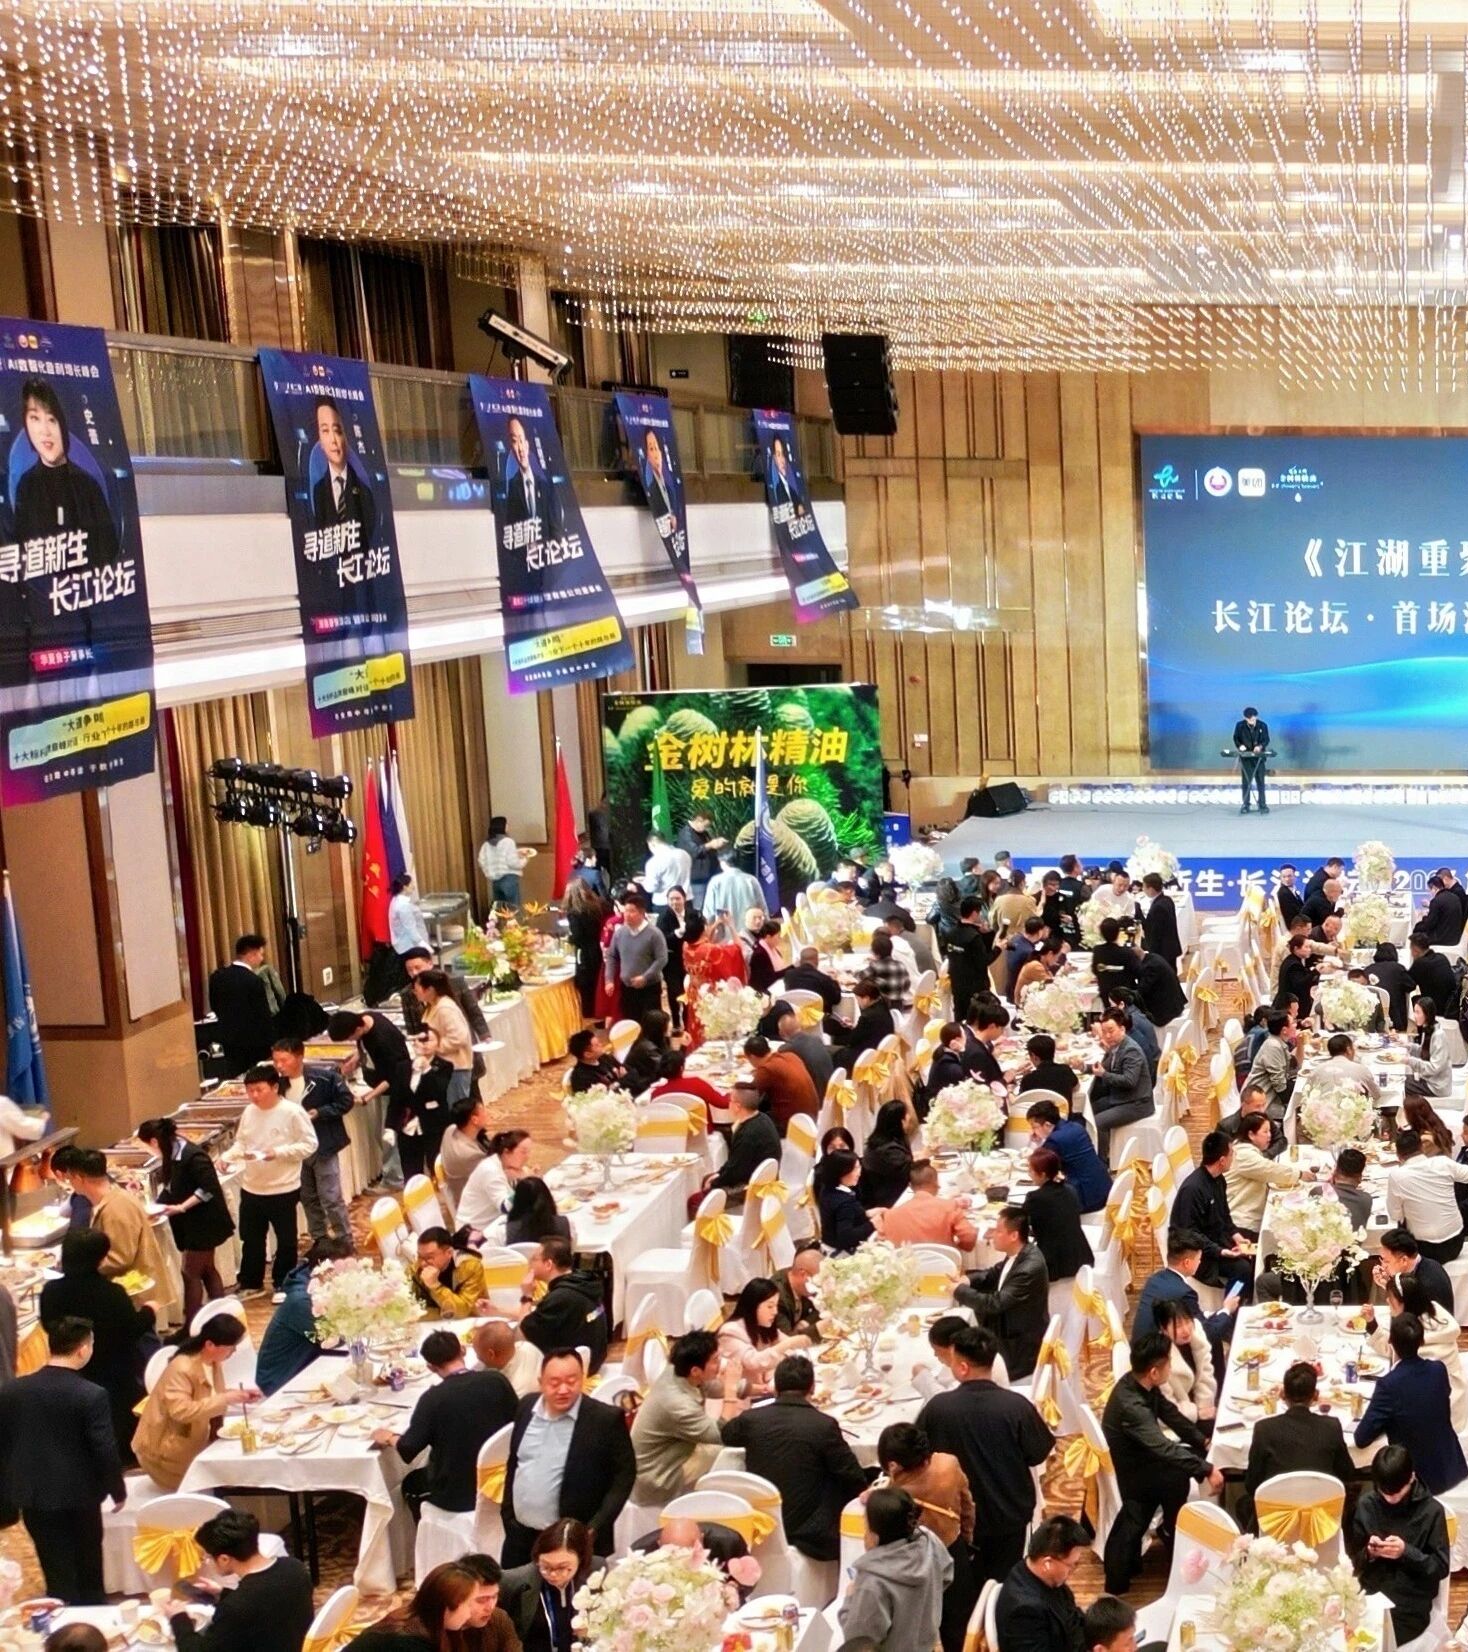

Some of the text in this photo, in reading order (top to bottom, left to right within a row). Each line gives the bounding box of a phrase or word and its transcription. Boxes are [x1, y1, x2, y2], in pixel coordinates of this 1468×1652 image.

[0, 529, 88, 583] 寻道新生
[49, 559, 136, 616] 长江论坛
[644, 727, 848, 770] 金树林精油
